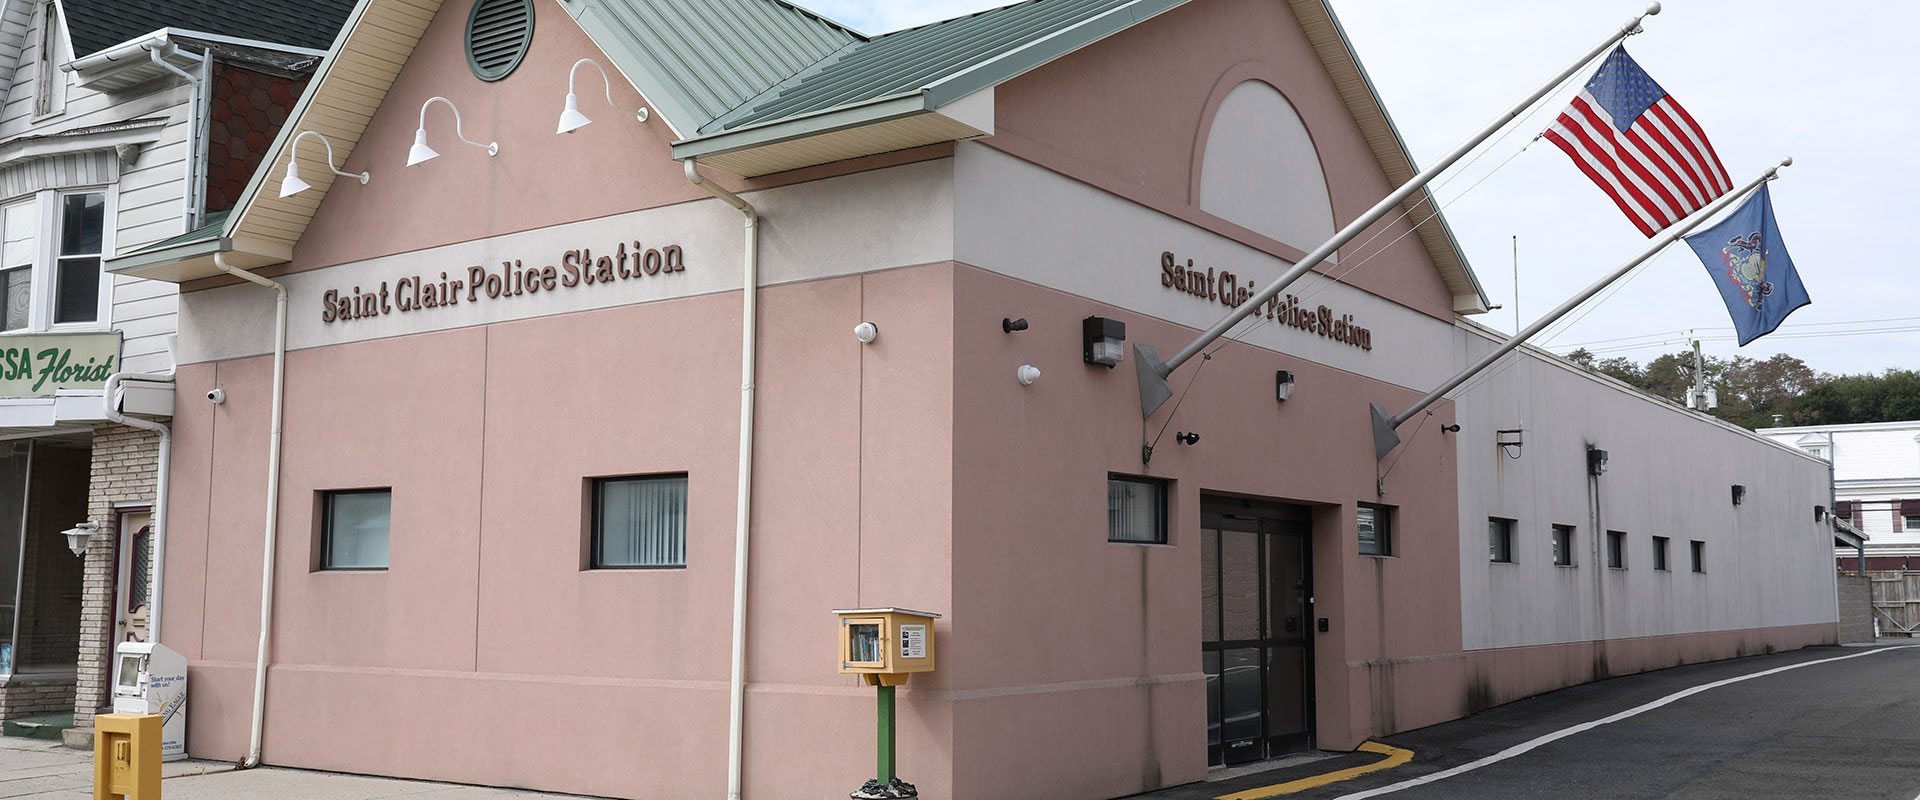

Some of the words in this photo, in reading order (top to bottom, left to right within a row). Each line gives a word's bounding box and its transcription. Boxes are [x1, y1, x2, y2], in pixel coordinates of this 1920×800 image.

[322, 281, 391, 322] Saint
[394, 271, 464, 312] Clair
[466, 259, 557, 302] Police
[561, 240, 686, 287] Station
[1161, 251, 1217, 302] Saint
[1266, 292, 1316, 333] Police
[1317, 304, 1373, 352] Station
[32, 348, 114, 392] Florist
